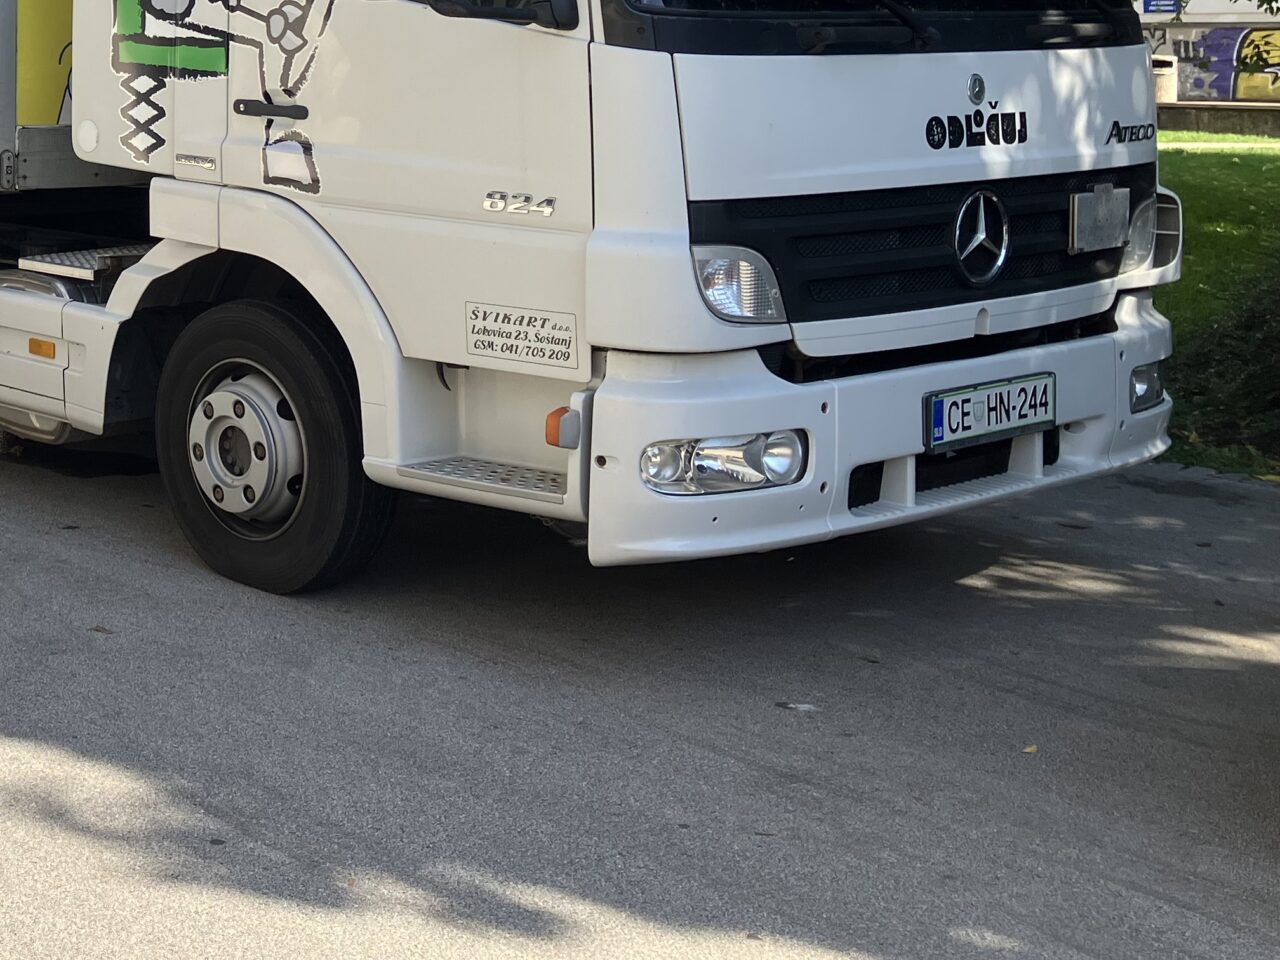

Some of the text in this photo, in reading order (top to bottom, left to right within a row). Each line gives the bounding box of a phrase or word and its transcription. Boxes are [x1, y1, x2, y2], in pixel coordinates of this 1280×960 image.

[482, 190, 557, 217] 824
[470, 306, 572, 333] ŠVIKART d.o.o.
[472, 324, 513, 339] Lokovica
[533, 329, 572, 350] Šoštanj
[474, 338, 571, 362] GSM: 041/705 209
[947, 383, 1049, 434] CE HN-244
